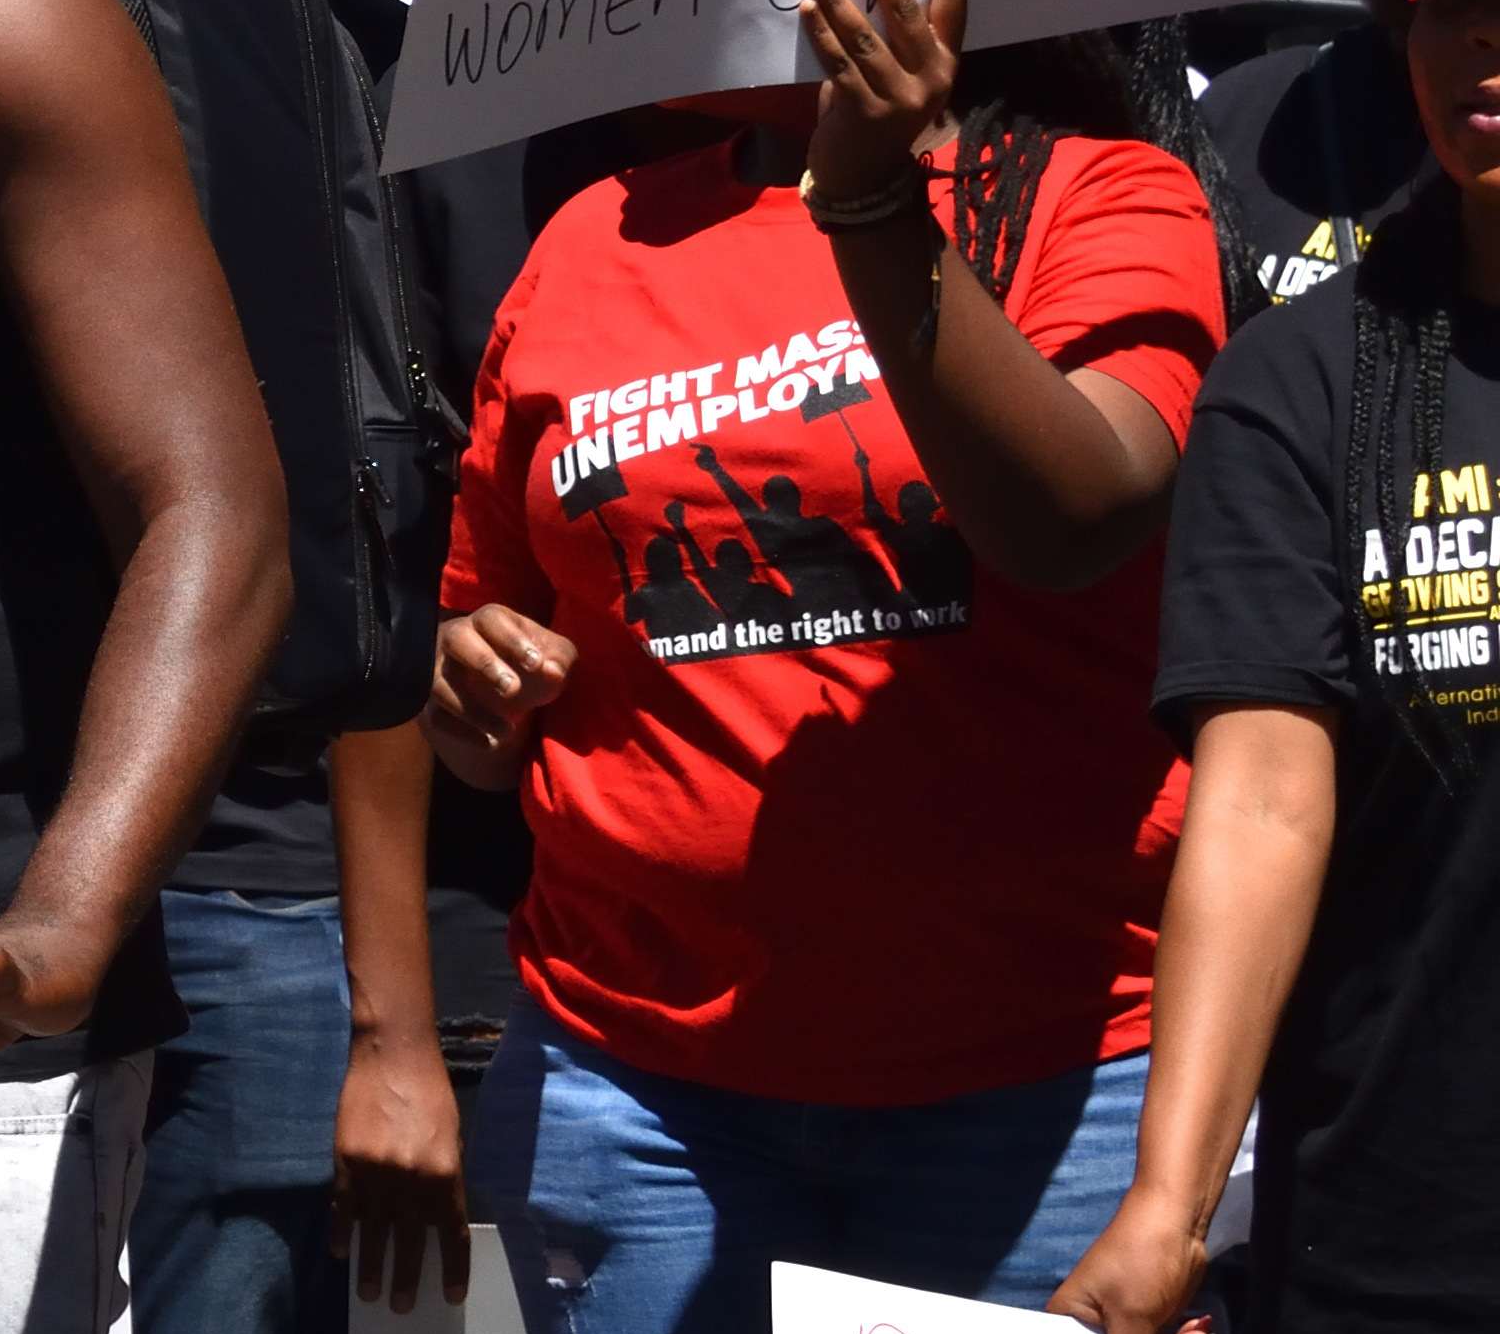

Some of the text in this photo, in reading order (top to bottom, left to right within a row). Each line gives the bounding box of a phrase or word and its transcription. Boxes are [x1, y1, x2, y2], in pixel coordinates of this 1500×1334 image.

[550, 348, 882, 499] UNEMPLOYM
[568, 361, 724, 436] FIGHT
[734, 619, 784, 648] the
[790, 608, 866, 646] right
[872, 606, 902, 633] to
